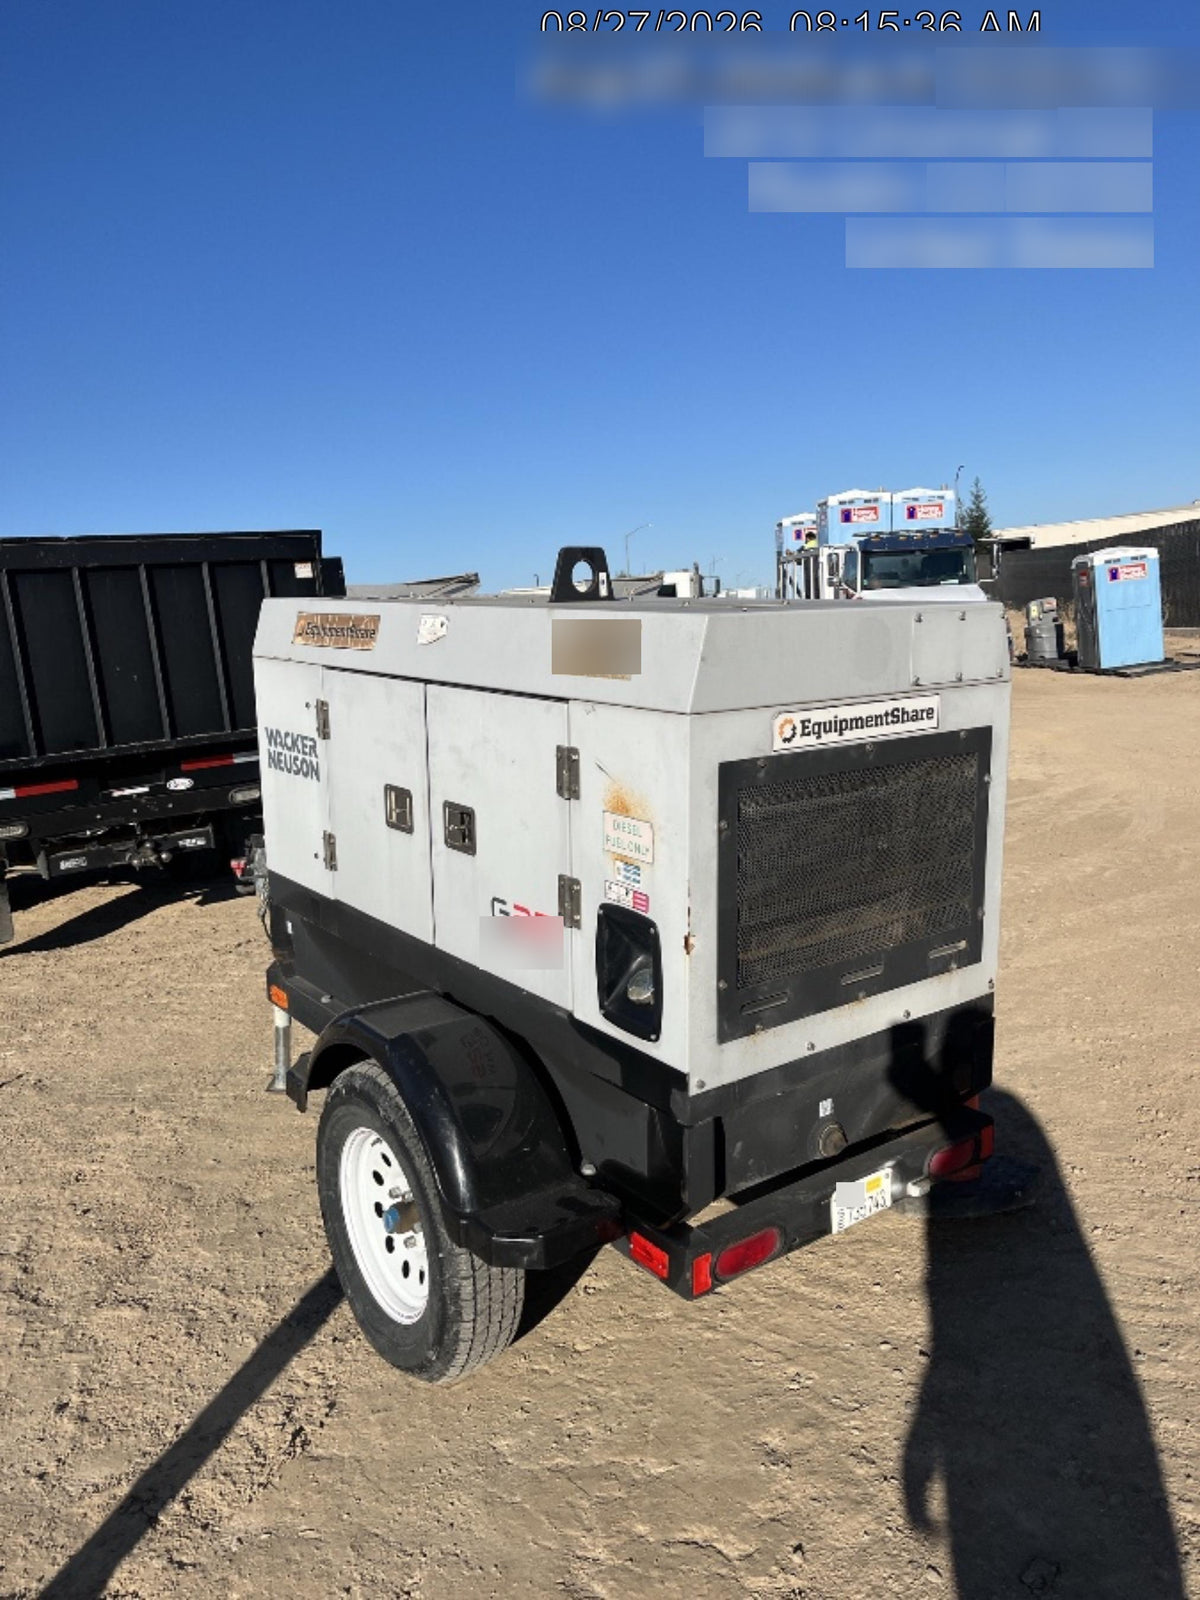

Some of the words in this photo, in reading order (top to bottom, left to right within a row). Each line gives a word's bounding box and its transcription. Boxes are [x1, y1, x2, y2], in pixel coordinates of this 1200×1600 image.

[800, 707, 935, 740] EquipmentShare
[264, 726, 318, 759] WACKER
[267, 748, 320, 782] NEUSON
